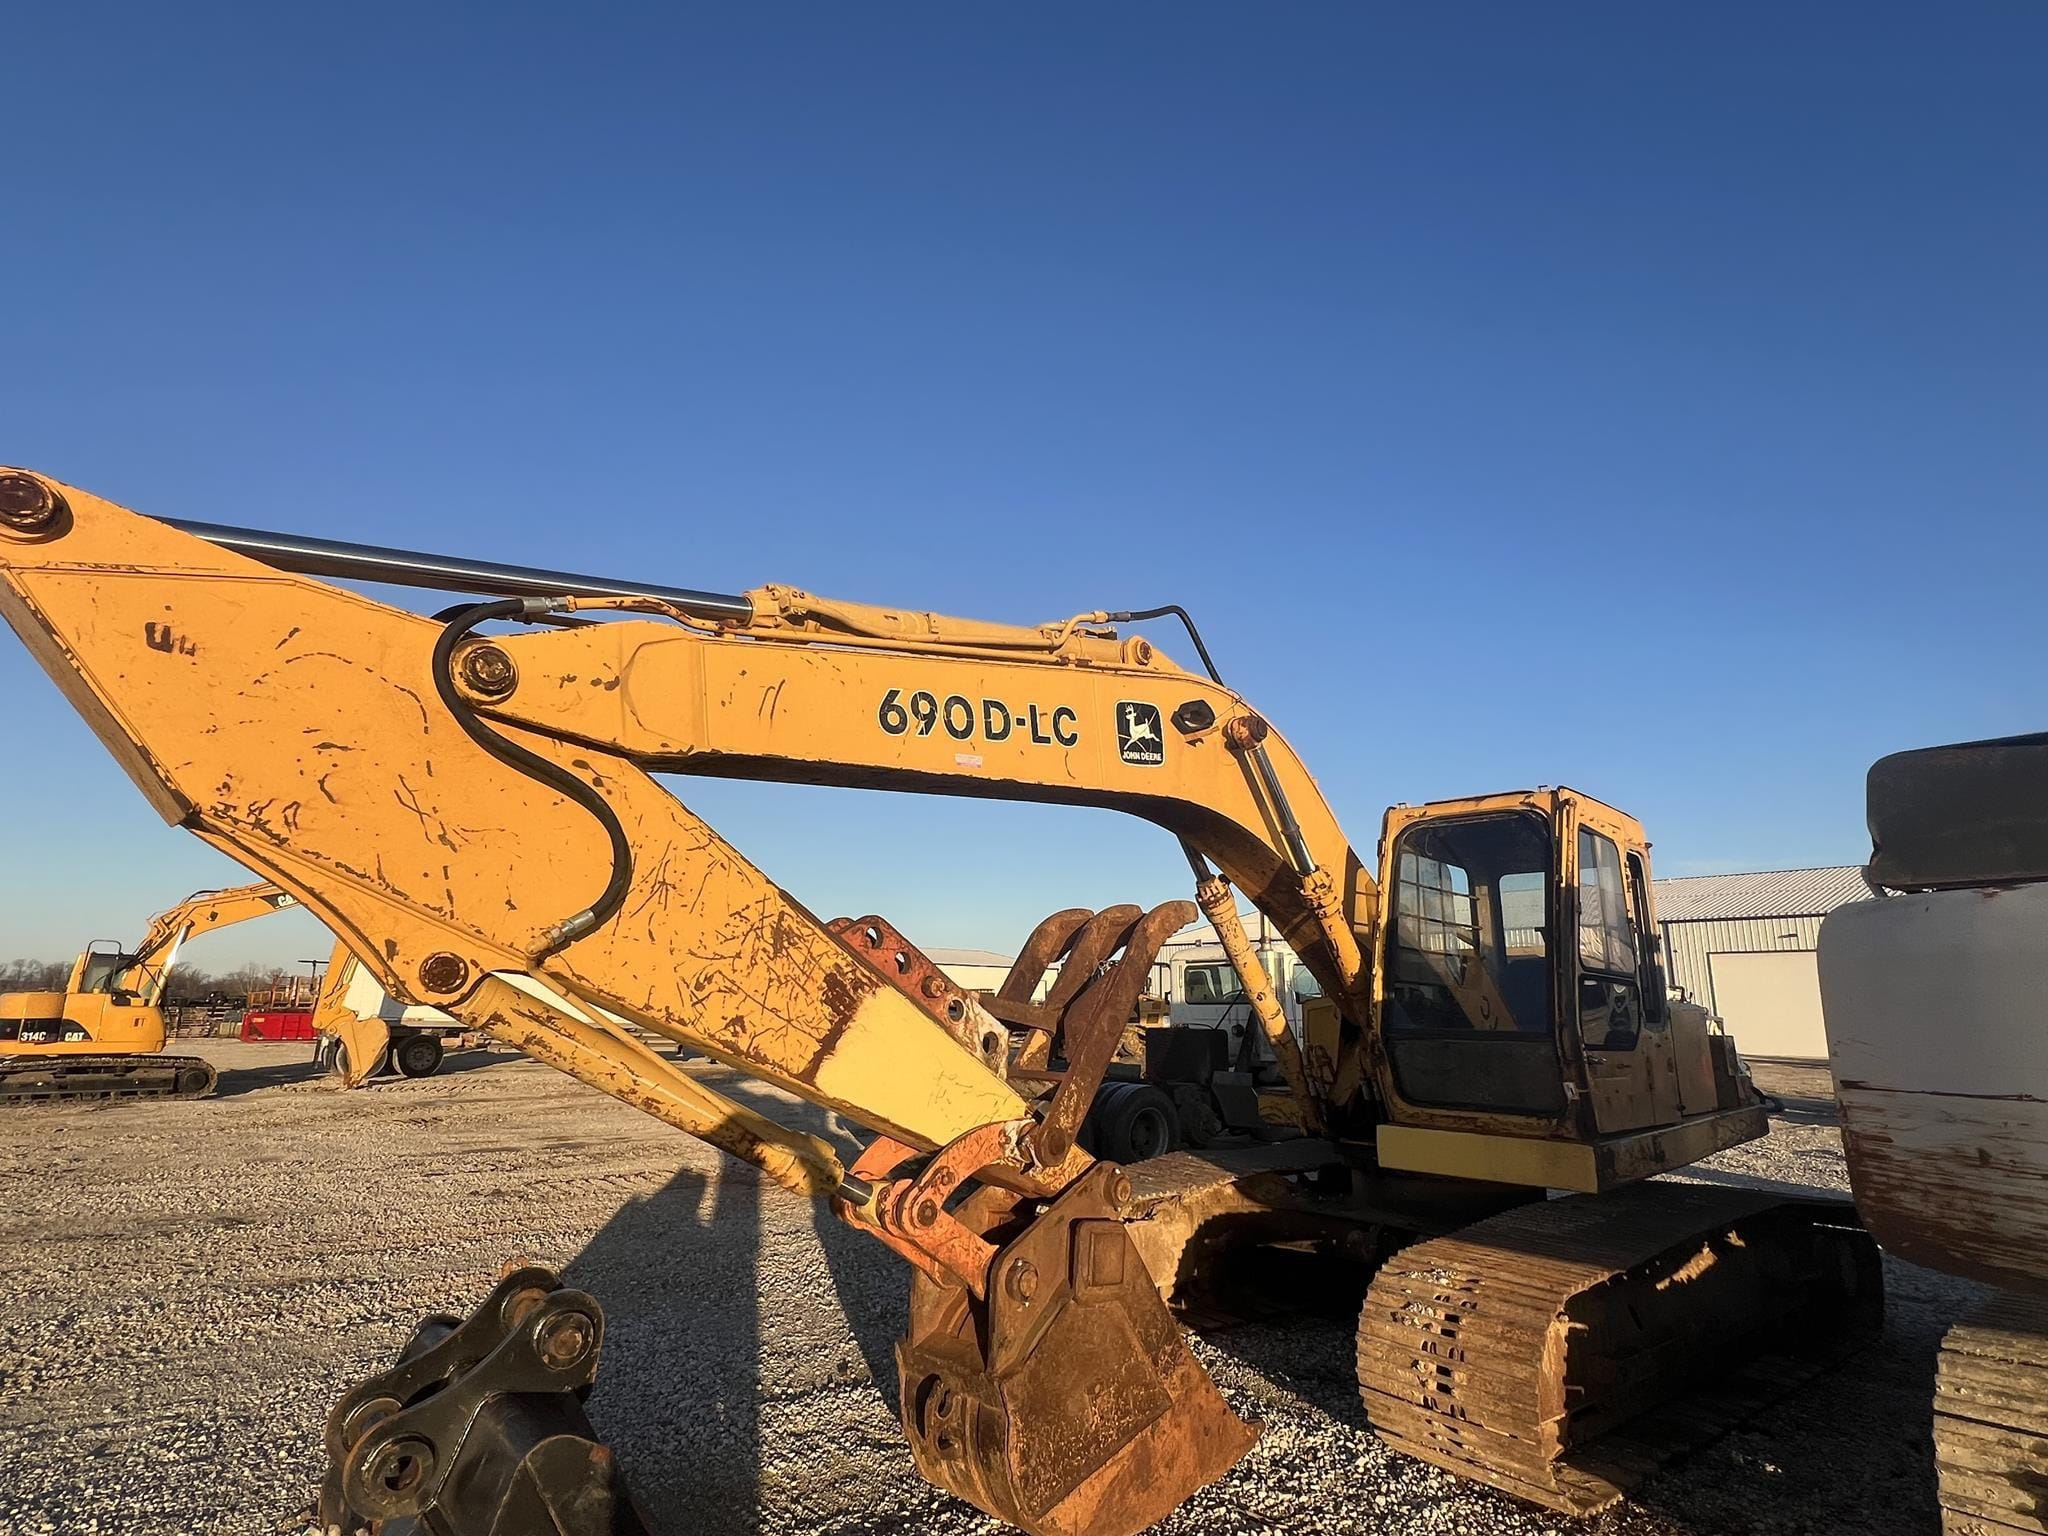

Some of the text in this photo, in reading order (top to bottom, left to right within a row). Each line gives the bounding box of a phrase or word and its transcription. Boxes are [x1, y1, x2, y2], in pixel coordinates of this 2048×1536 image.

[878, 689, 1079, 748] 690D-LC
[1122, 751, 1162, 761] JOHN DEERE
[277, 894, 298, 907] CA
[21, 1031, 47, 1042] 314C
[64, 1031, 85, 1042] CAT
